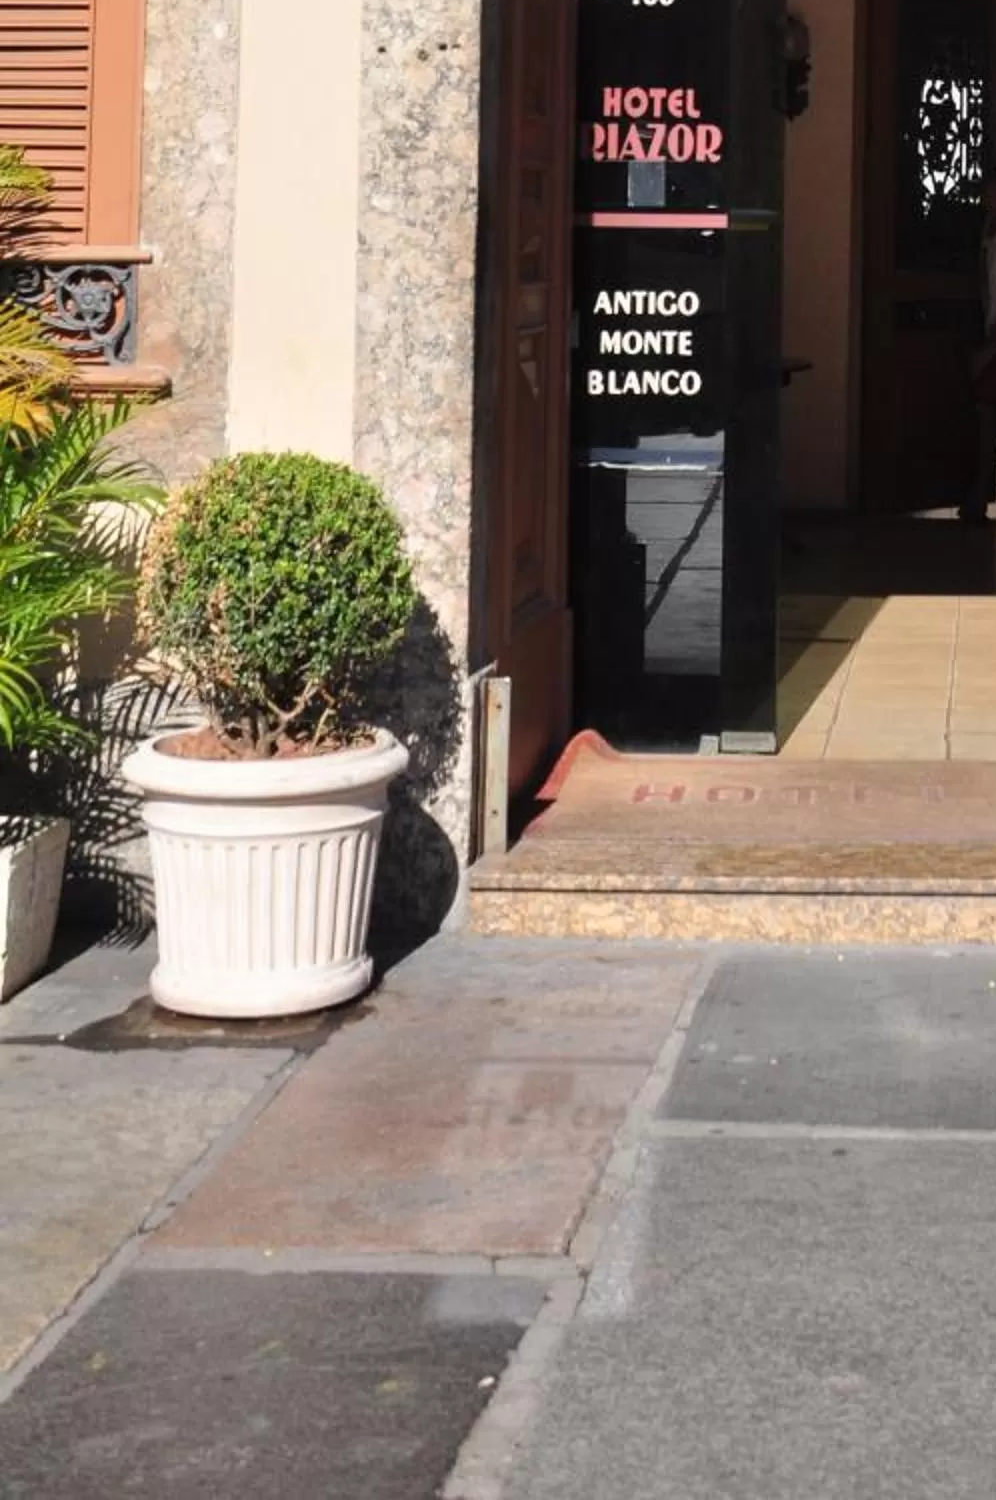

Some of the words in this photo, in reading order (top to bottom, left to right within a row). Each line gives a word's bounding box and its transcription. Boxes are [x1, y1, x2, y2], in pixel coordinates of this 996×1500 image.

[602, 87, 702, 119] HOTEL
[581, 122, 724, 163] RIAZOR
[593, 289, 700, 317] ANTIGO
[599, 329, 693, 357] MONTE
[587, 369, 702, 396] BLANCO
